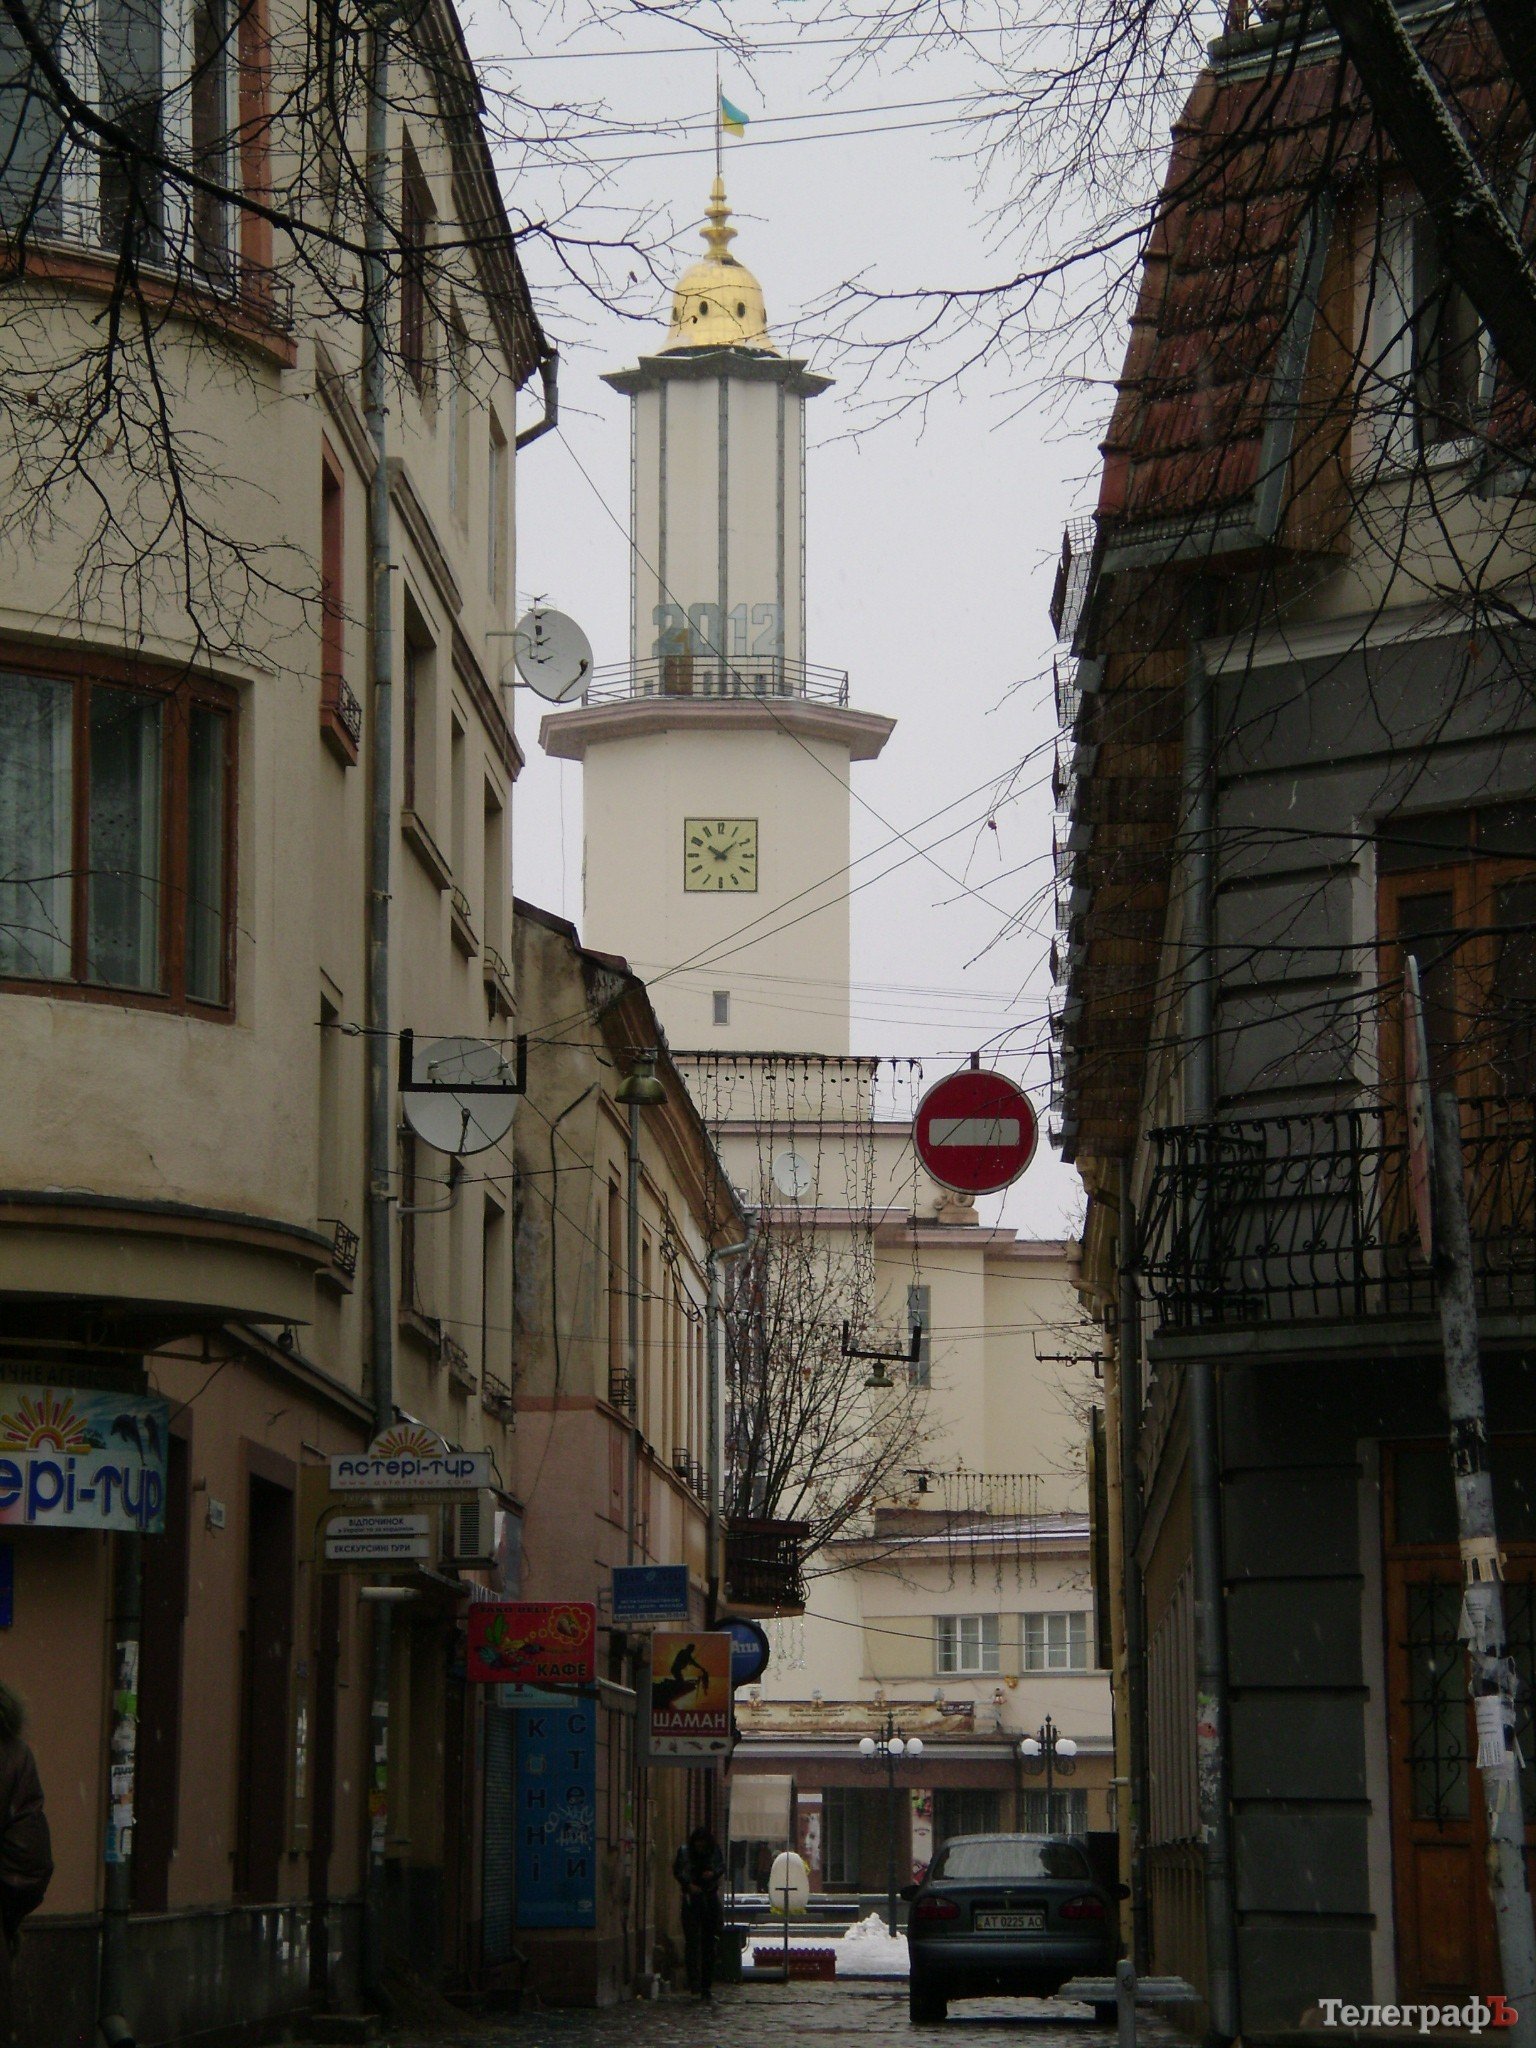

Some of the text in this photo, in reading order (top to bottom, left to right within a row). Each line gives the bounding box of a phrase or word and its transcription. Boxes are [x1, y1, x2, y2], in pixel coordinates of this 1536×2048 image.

[652, 603, 783, 656] 2012
[717, 822, 725, 835] 12
[348, 1518, 404, 1526] ВІДПОЧИНОК
[334, 1544, 410, 1553] ЕКСКУРСІЙНІ ТУРИ
[731, 1640, 760, 1654] AZZA
[537, 1663, 586, 1677] КАФЕ
[653, 1712, 725, 1728] ШАМАН
